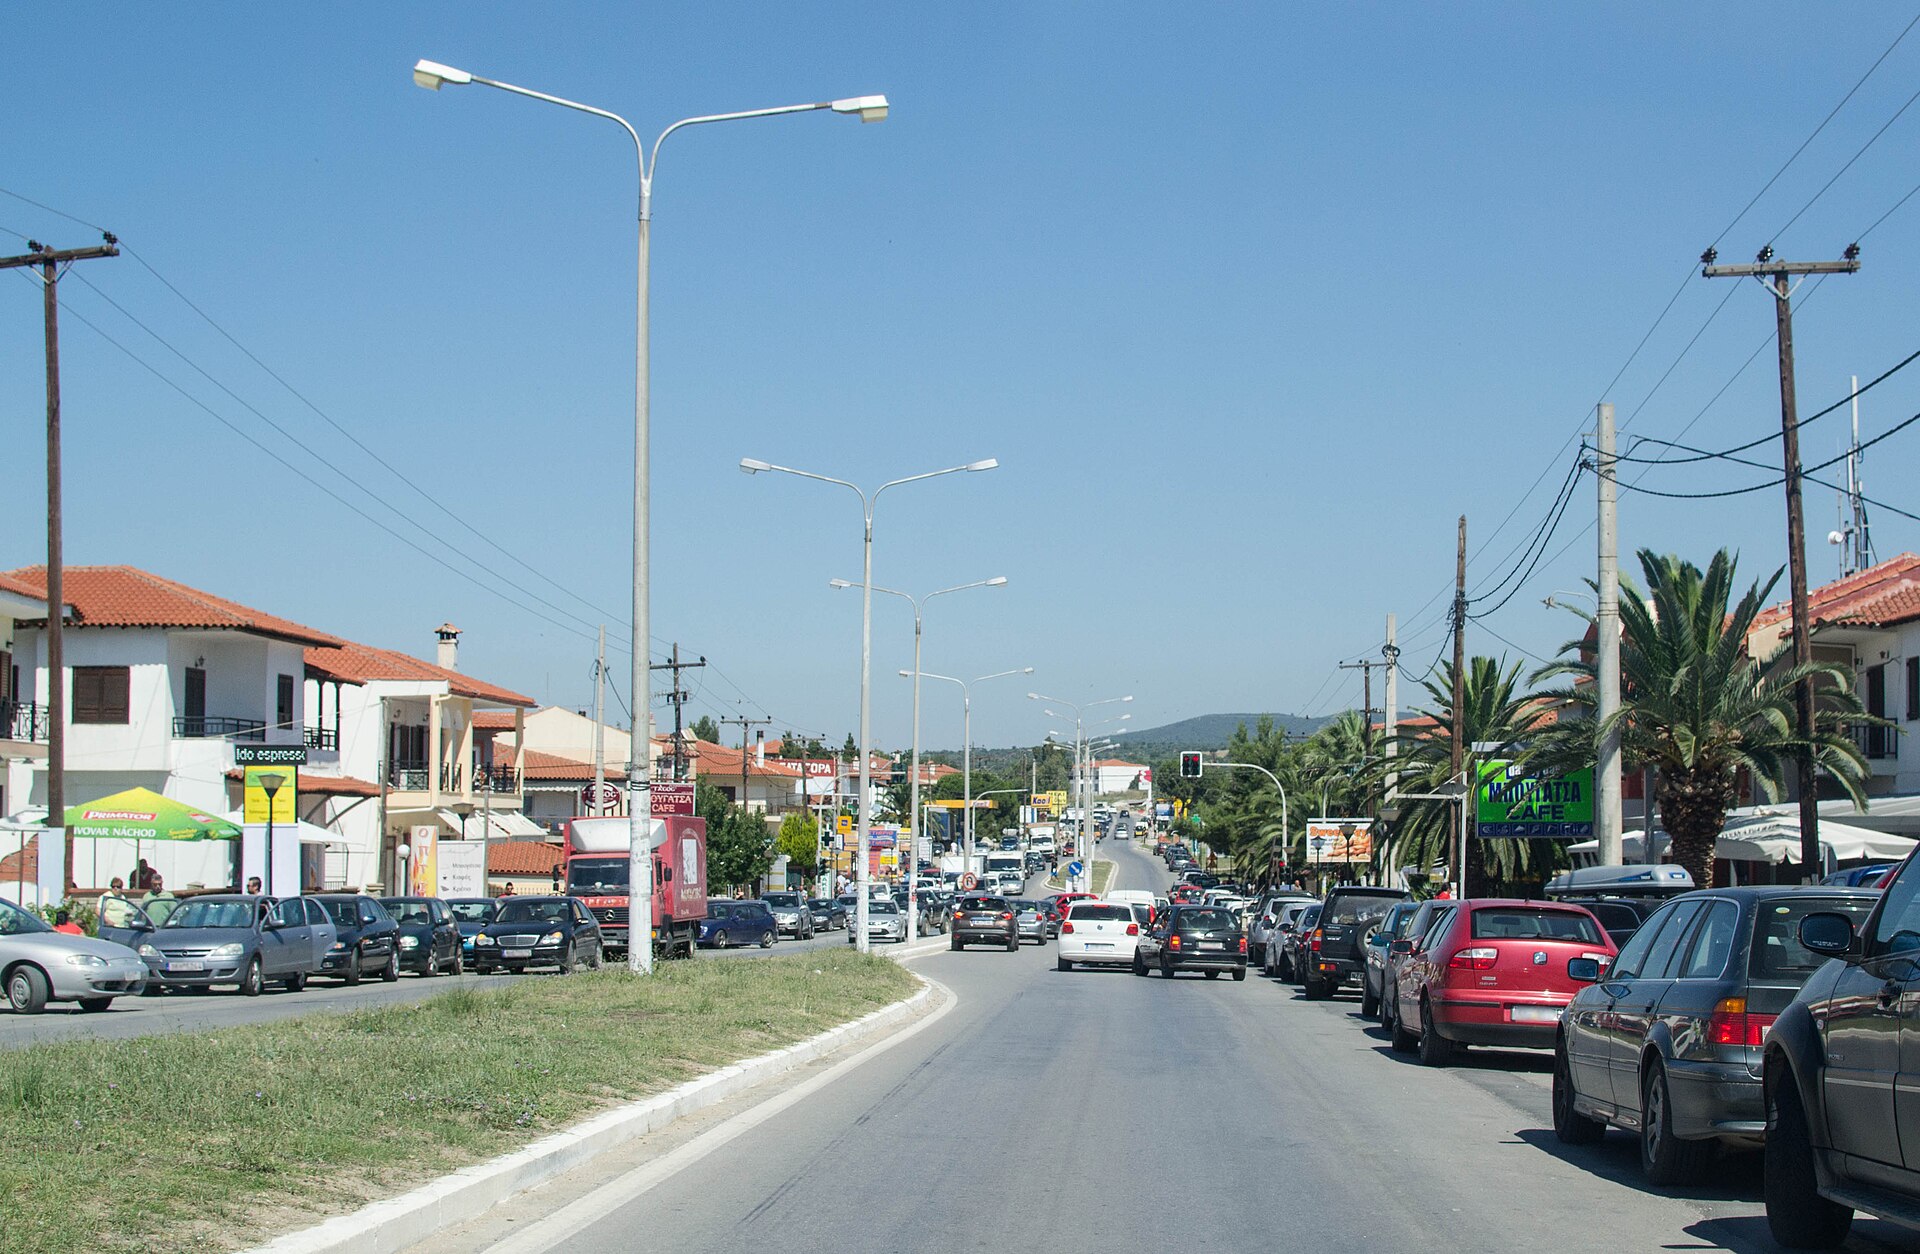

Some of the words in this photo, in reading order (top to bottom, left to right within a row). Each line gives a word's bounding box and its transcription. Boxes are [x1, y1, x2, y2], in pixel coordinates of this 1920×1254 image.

[780, 763, 832, 774] ΑΤΑΟΡΑ
[651, 794, 692, 804] ΟΥΓΑΤΣΑ
[652, 804, 675, 812] CAFE
[1506, 804, 1564, 820] CAFE
[88, 811, 153, 821] PRIMATOR
[74, 826, 109, 837] IVOVAR
[112, 825, 156, 838] NÁCHOD
[1310, 826, 1342, 837] Swee
